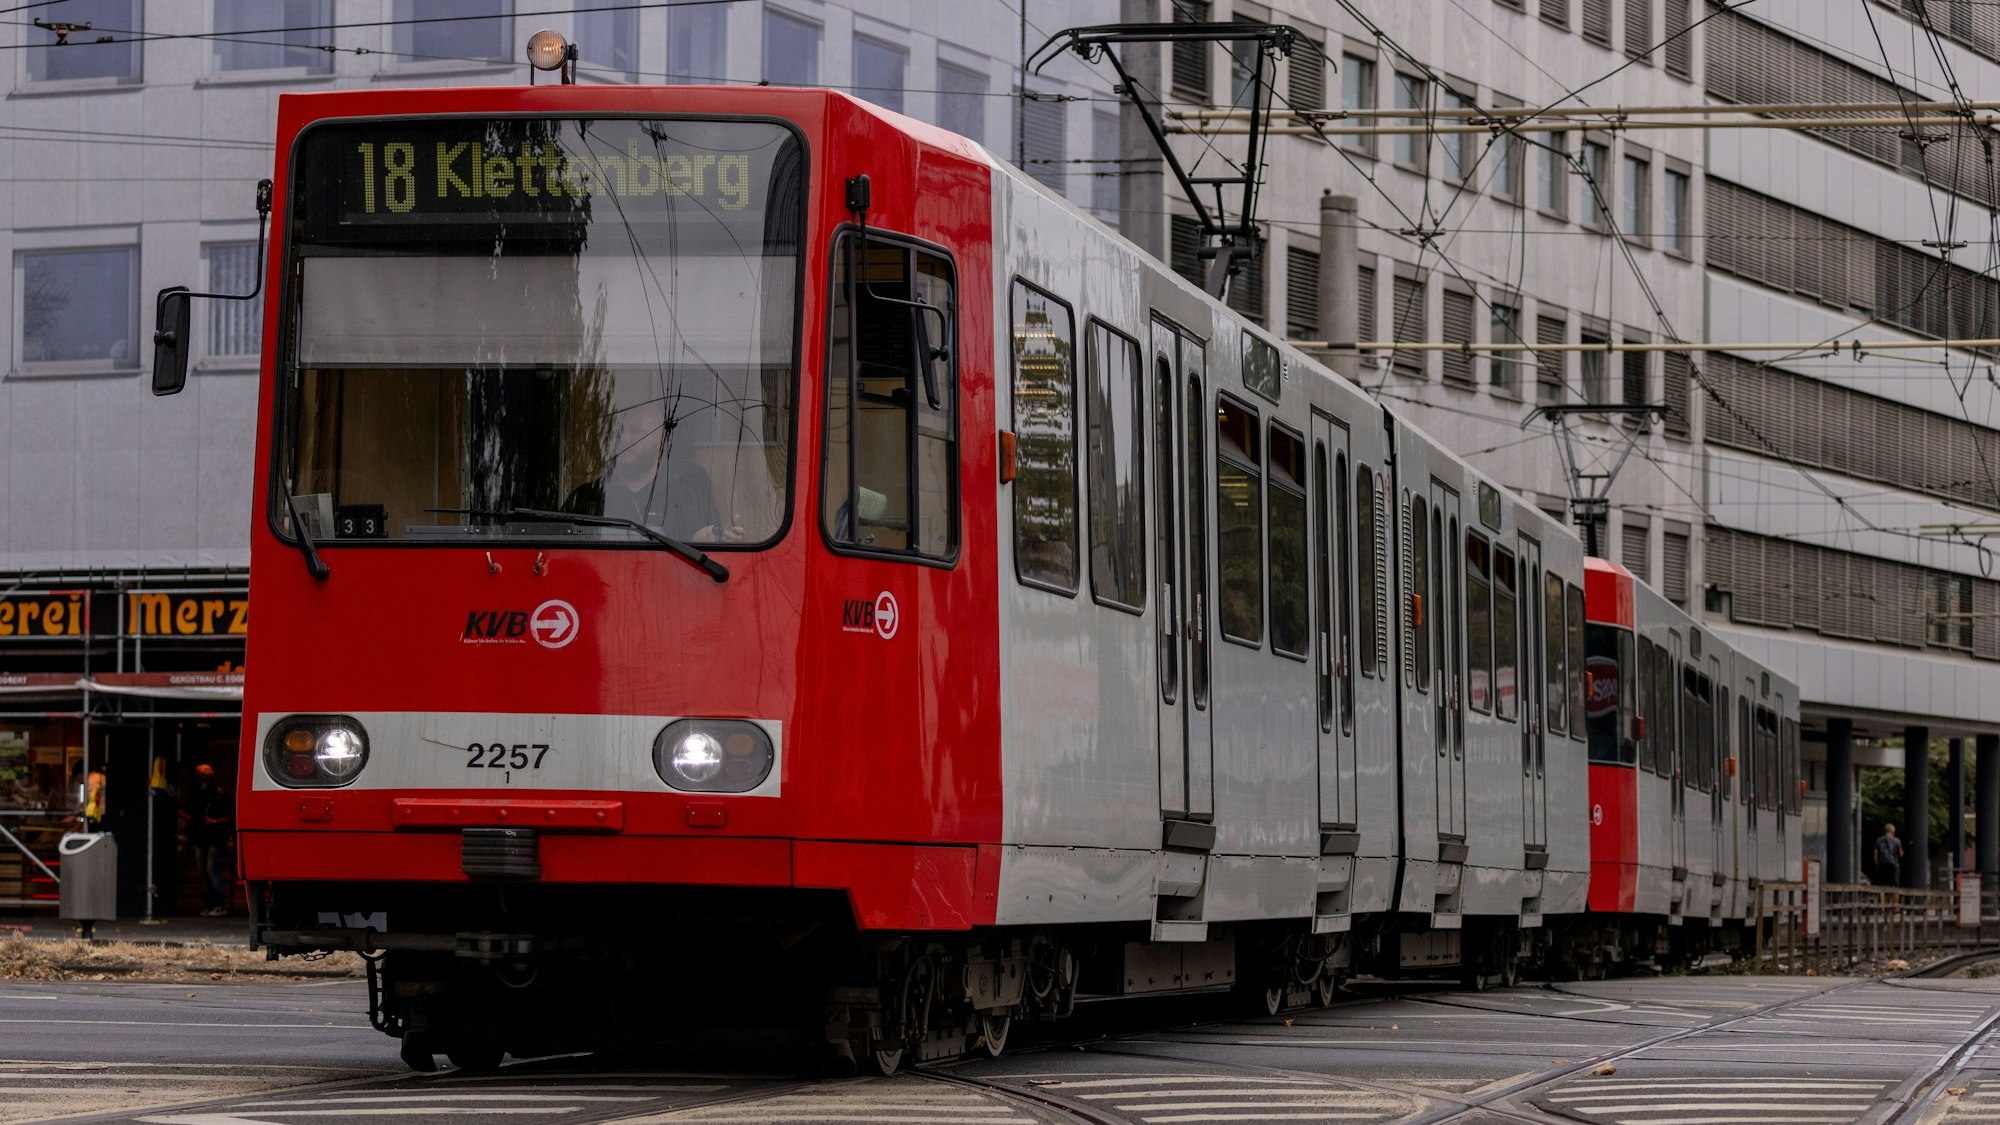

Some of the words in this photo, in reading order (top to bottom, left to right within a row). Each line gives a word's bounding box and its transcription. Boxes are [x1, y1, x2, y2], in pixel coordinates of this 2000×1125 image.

[358, 143, 416, 213] 18
[436, 138, 749, 211] Klettenberg
[0, 592, 82, 635] erei
[128, 592, 249, 635] Merz
[464, 611, 529, 638] KVB
[842, 599, 875, 627] KVB
[466, 743, 550, 770] 2257
[504, 770, 510, 784] 1
